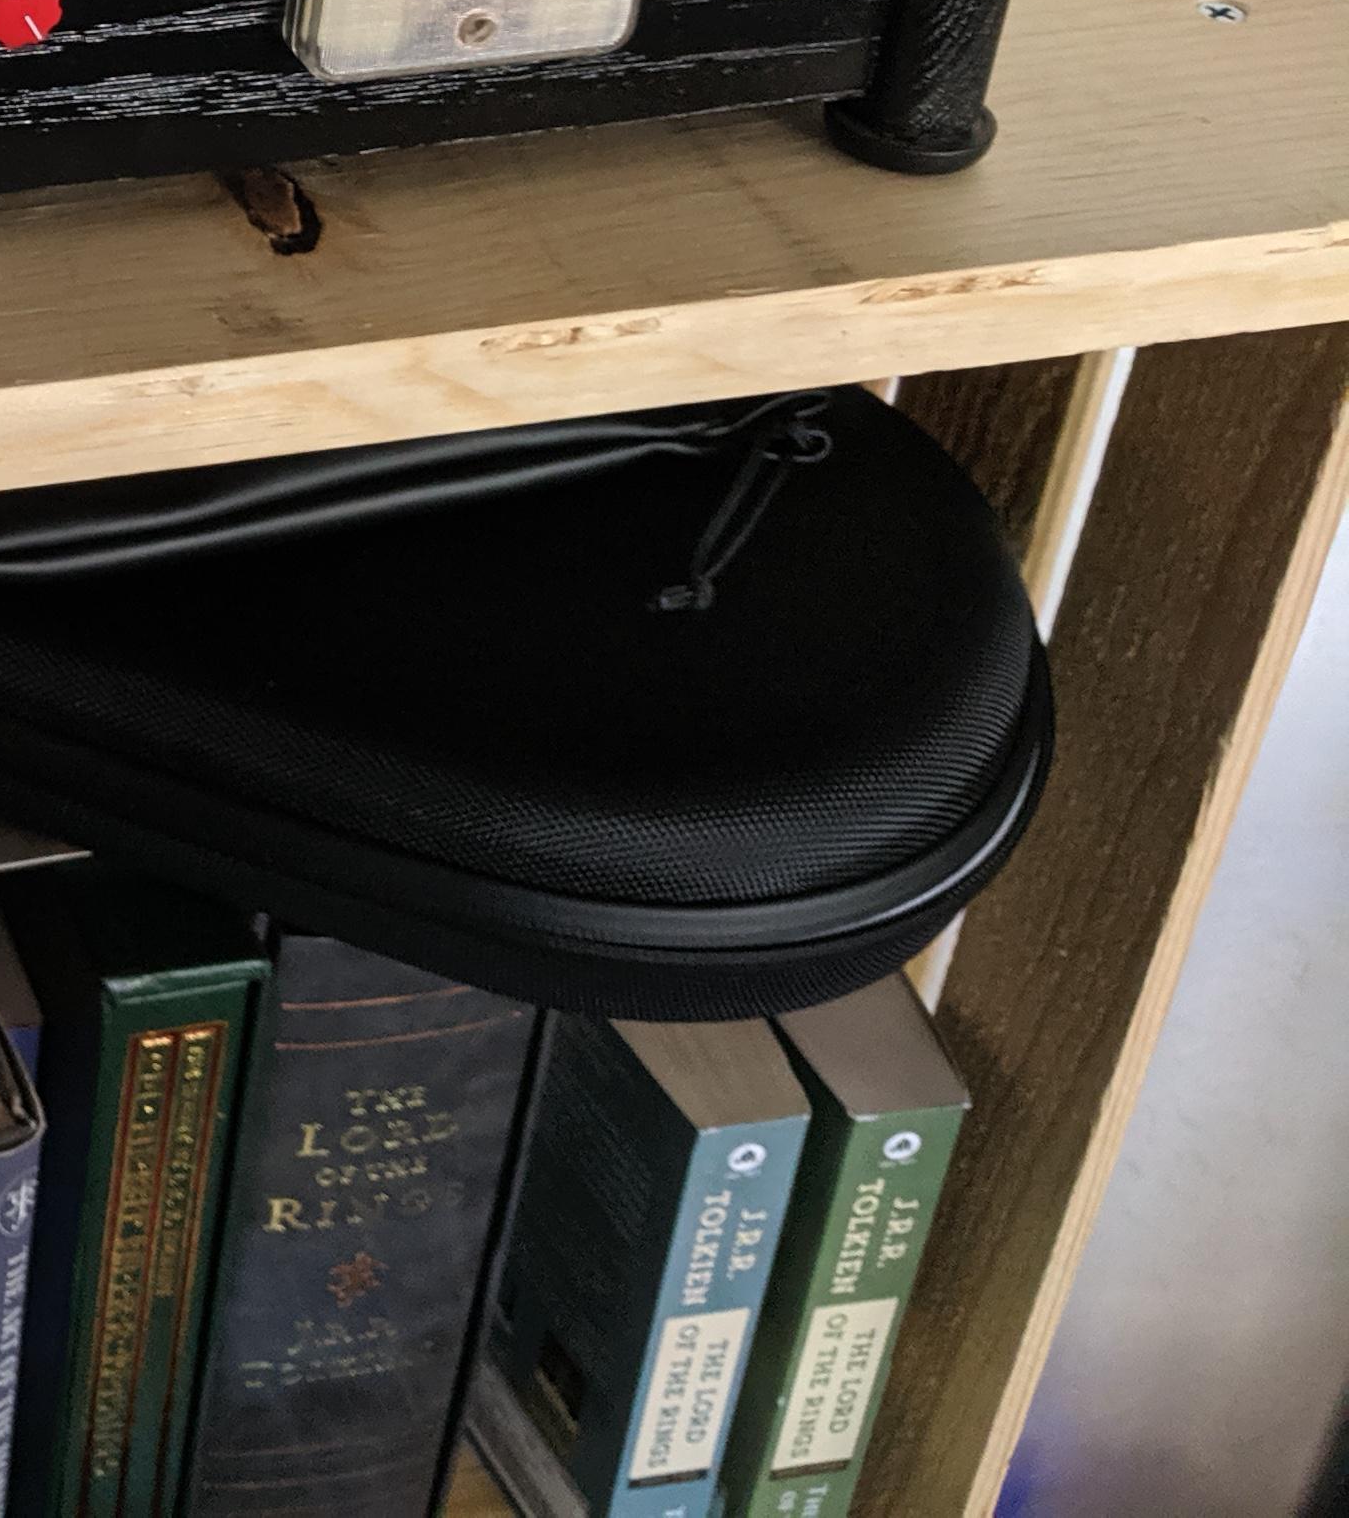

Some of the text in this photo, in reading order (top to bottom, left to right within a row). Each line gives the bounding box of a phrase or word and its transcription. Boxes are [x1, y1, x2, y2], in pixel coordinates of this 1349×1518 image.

[295, 1111, 459, 1158] LORD
[682, 1189, 731, 1306] TOLKIEN
[726, 1208, 767, 1281] J.R.R.
[830, 1178, 885, 1294] TOLKIEN
[876, 1197, 919, 1269] J.R.R.
[663, 1355, 693, 1399] THE
[700, 1338, 729, 1382] THE
[809, 1345, 839, 1389] THE
[828, 1328, 876, 1434] THE LORD
[790, 1395, 825, 1460] RINGS
